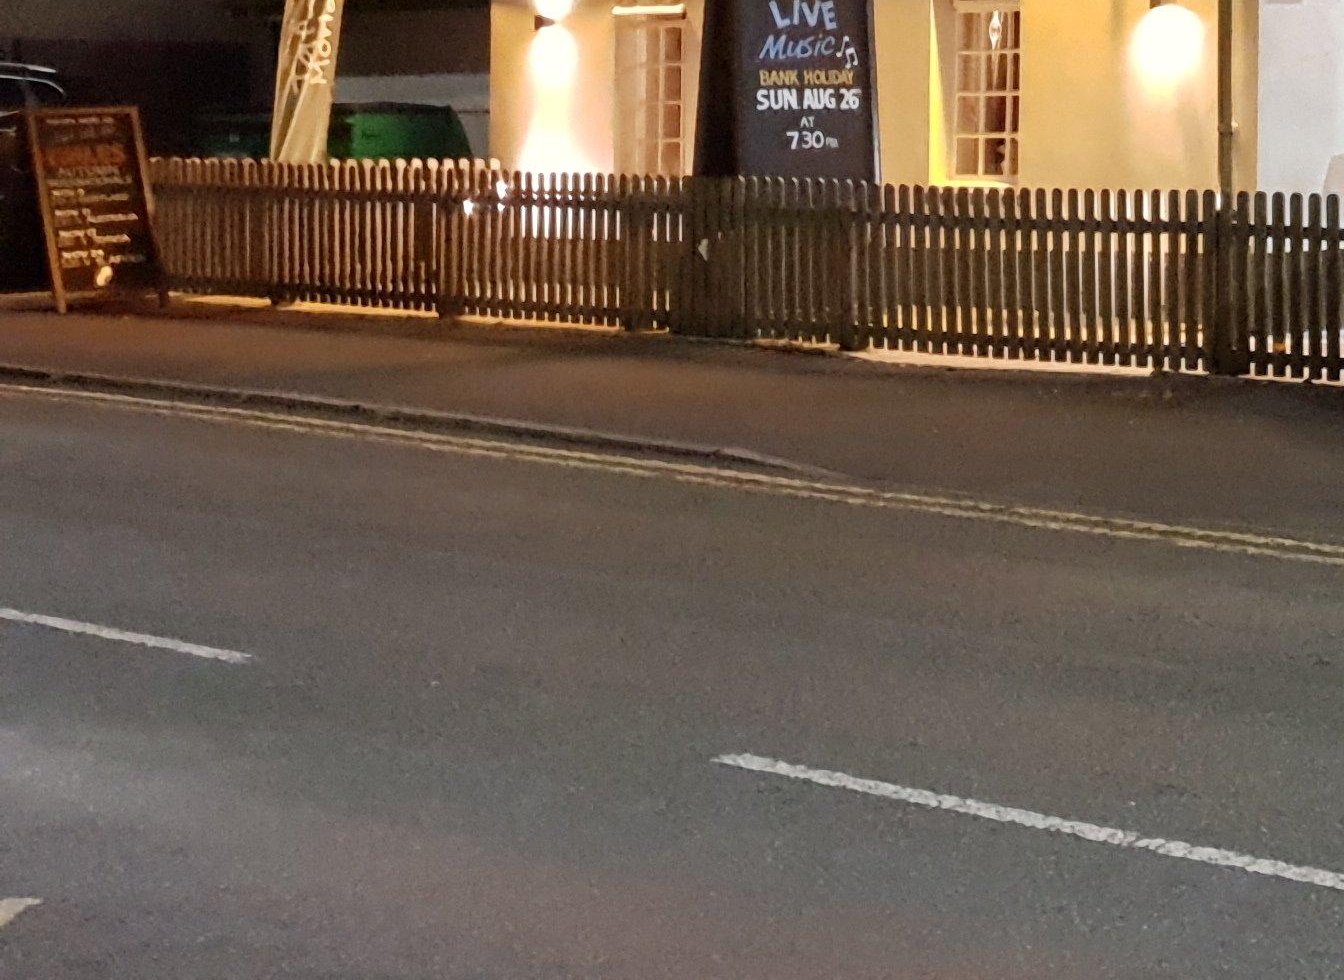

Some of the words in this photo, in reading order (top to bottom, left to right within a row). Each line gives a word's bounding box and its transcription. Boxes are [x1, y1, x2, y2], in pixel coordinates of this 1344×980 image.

[759, 69, 799, 87] BANK
[803, 69, 855, 86] HOLIDAY
[803, 88, 836, 111] AUG
[839, 88, 862, 111] 26
[800, 116, 815, 128] AT
